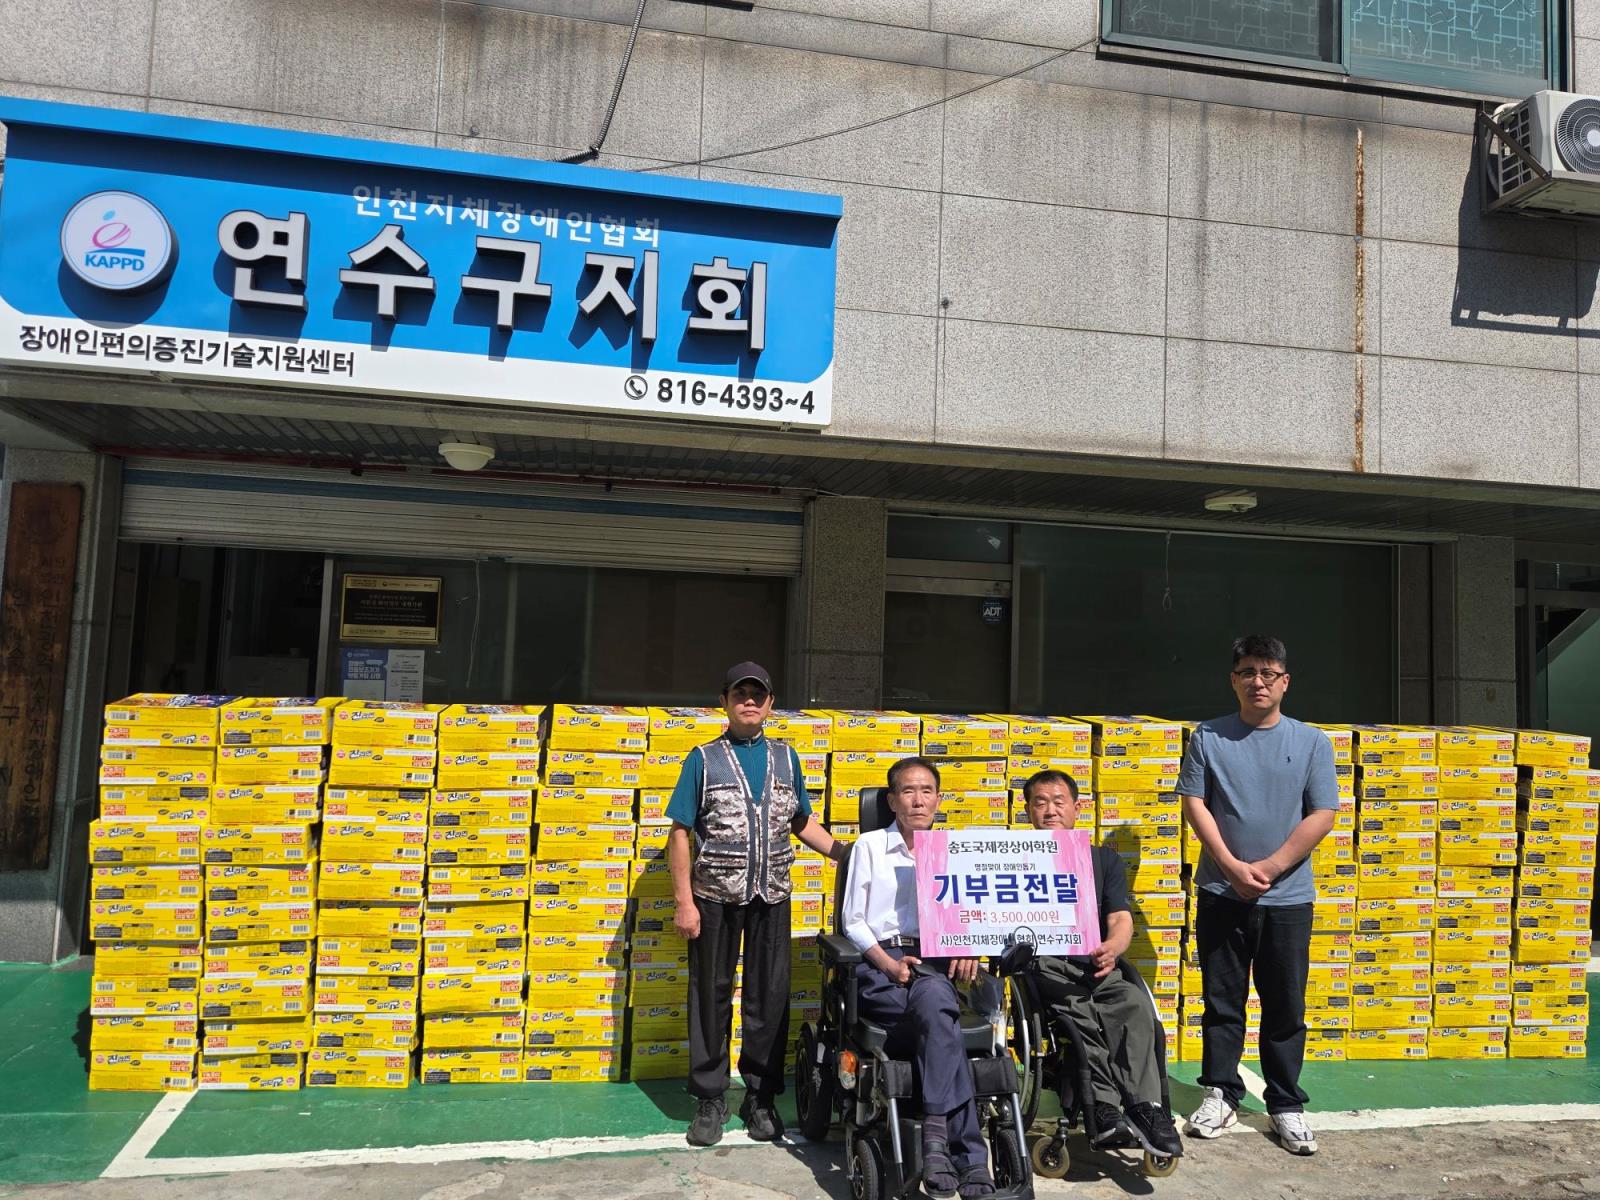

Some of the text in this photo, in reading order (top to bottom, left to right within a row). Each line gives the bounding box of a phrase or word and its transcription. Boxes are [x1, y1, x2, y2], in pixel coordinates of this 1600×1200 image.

[352, 185, 661, 248] 인천지체장애인협회
[85, 253, 145, 272] KAPPD
[217, 209, 768, 352] 연수구지회
[19, 325, 355, 377] 장애인편의증진기술지원센터
[657, 377, 815, 415] 816-4393~4
[983, 606, 1002, 617] ADT
[948, 840, 1058, 854] 송도국제정상어학원
[934, 874, 1078, 904] 기부금전달
[959, 910, 987, 924] 금액:
[1037, 933, 1082, 945] 연수구지회
